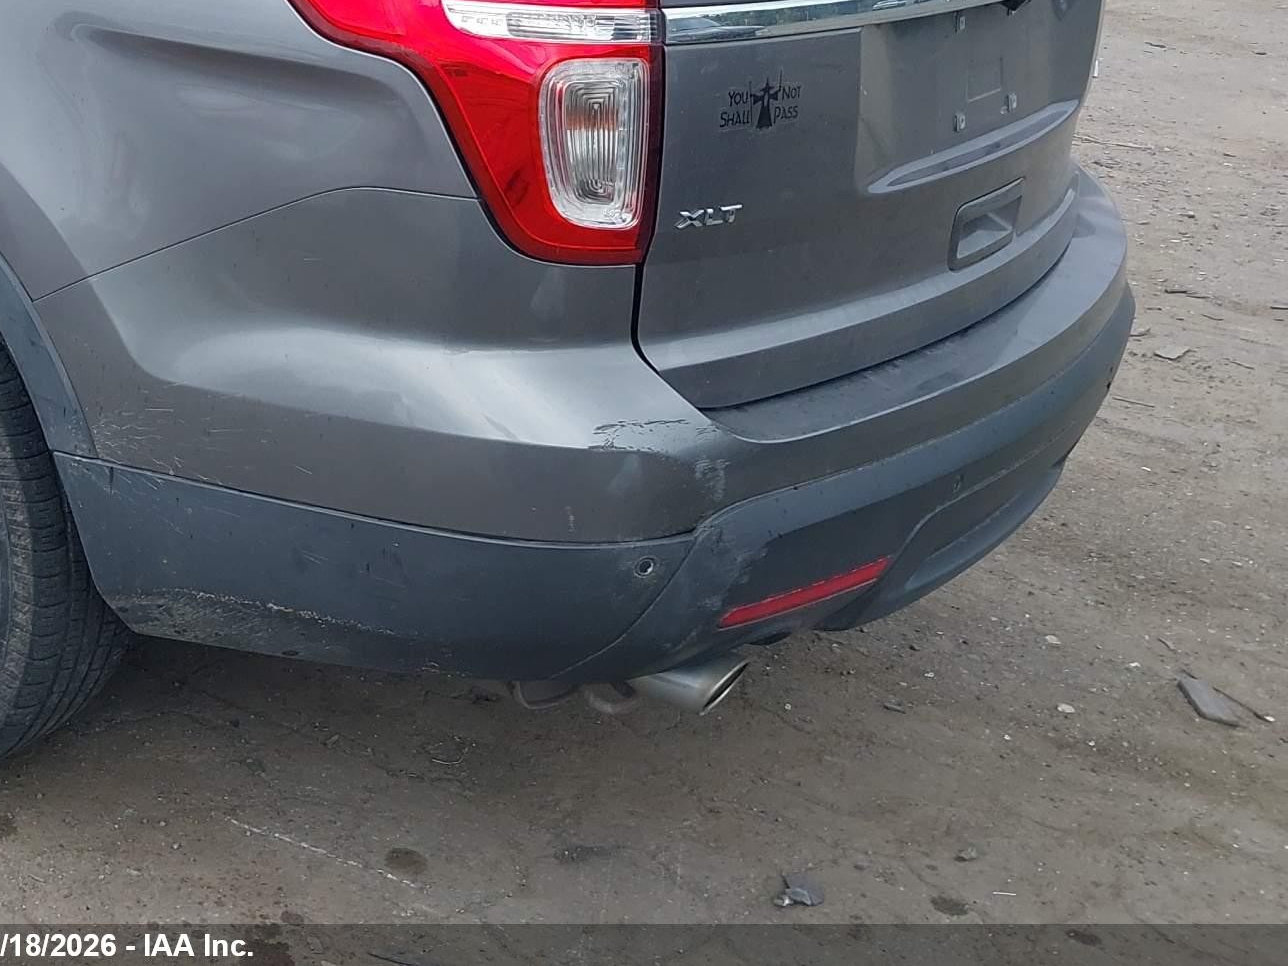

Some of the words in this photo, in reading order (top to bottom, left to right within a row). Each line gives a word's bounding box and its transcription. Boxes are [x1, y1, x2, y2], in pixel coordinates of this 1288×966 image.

[728, 90, 749, 107] YOU
[781, 85, 802, 101] NOT
[719, 109, 751, 128] SHALL
[773, 105, 799, 125] PASS
[674, 203, 744, 229] XLT
